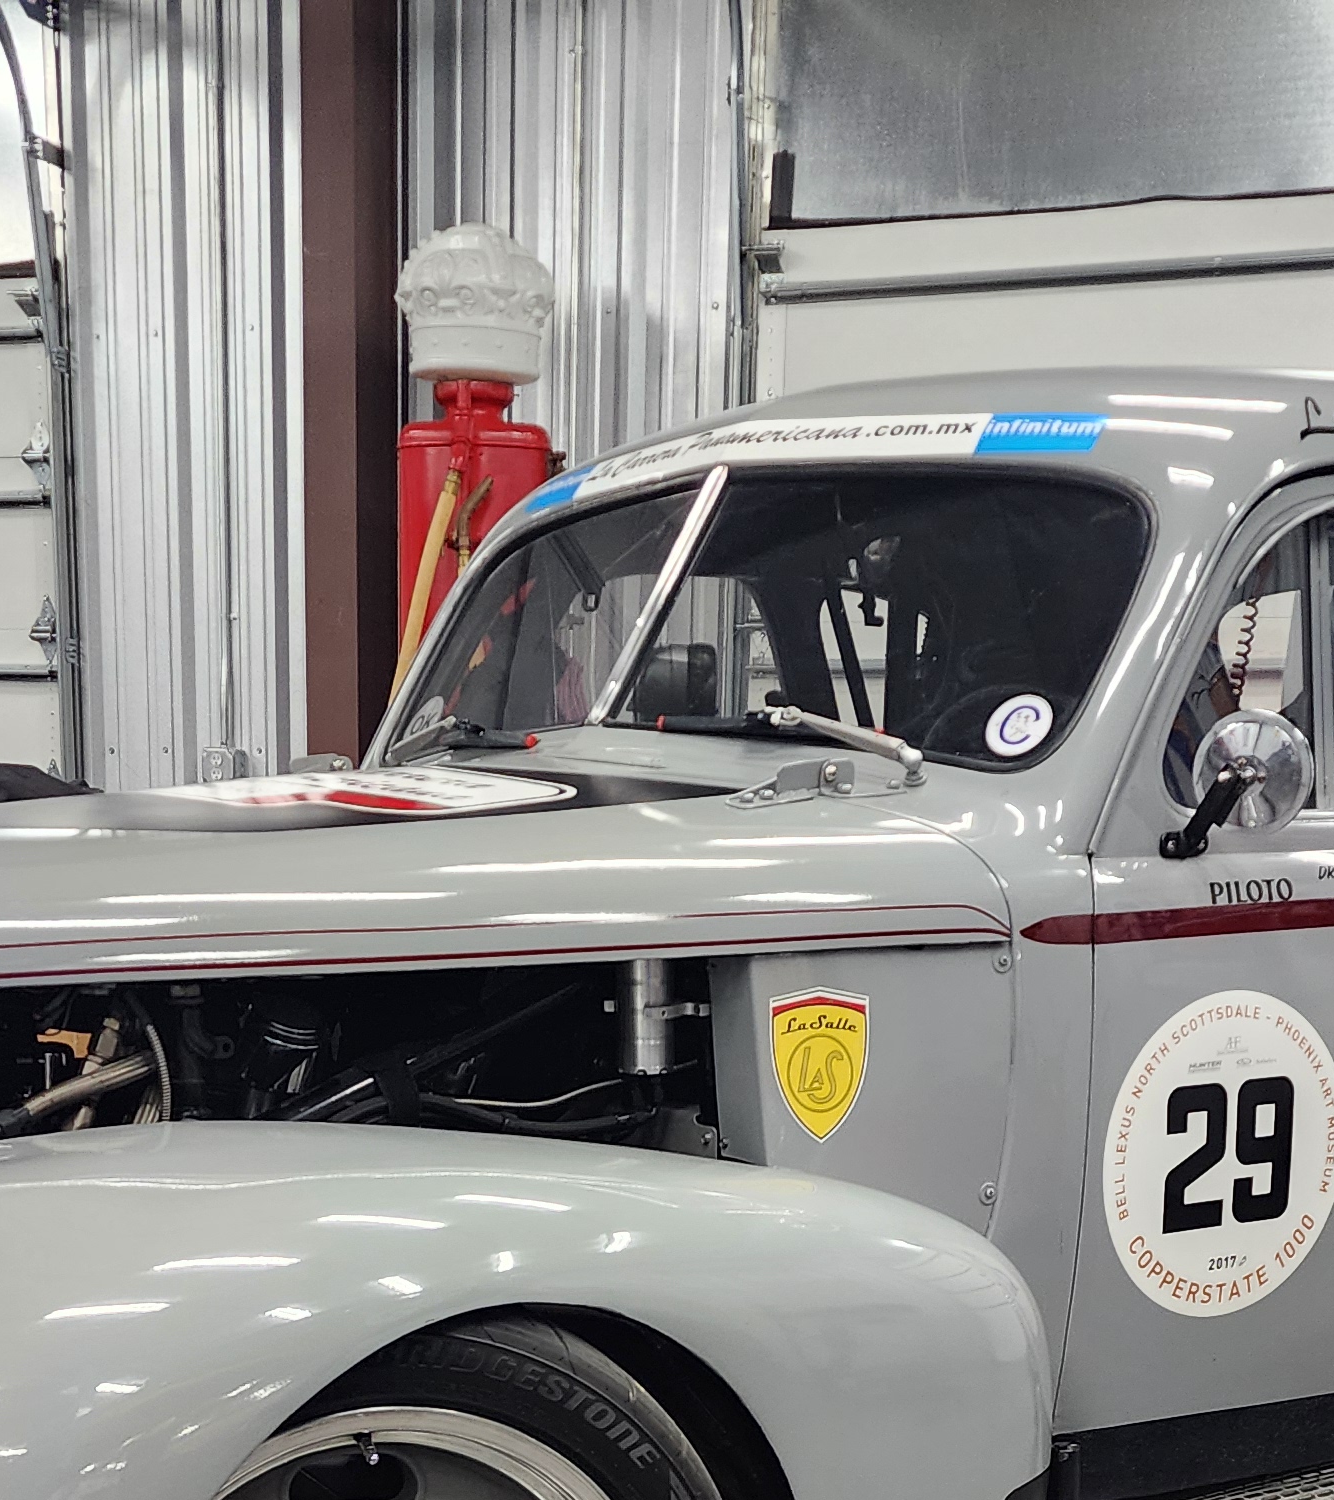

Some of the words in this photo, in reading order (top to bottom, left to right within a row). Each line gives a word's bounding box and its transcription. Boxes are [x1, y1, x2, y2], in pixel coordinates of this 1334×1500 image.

[983, 418, 1104, 437] infinitum
[999, 705, 1041, 745] C
[1209, 877, 1294, 905] PILOTO
[780, 1014, 858, 1036] LaSalle
[1171, 1004, 1262, 1046] SCOTTSDALE
[1275, 1016, 1323, 1073] PHOENIX
[1131, 1042, 1170, 1100] NORTH
[1114, 1105, 1136, 1166] LEXUS
[1162, 1075, 1295, 1235] 29
[1114, 1173, 1129, 1221] BELL
[1127, 1235, 1269, 1305] COPPERSTATE
[1274, 1213, 1315, 1268] 1000
[1208, 1255, 1237, 1271] 2017
